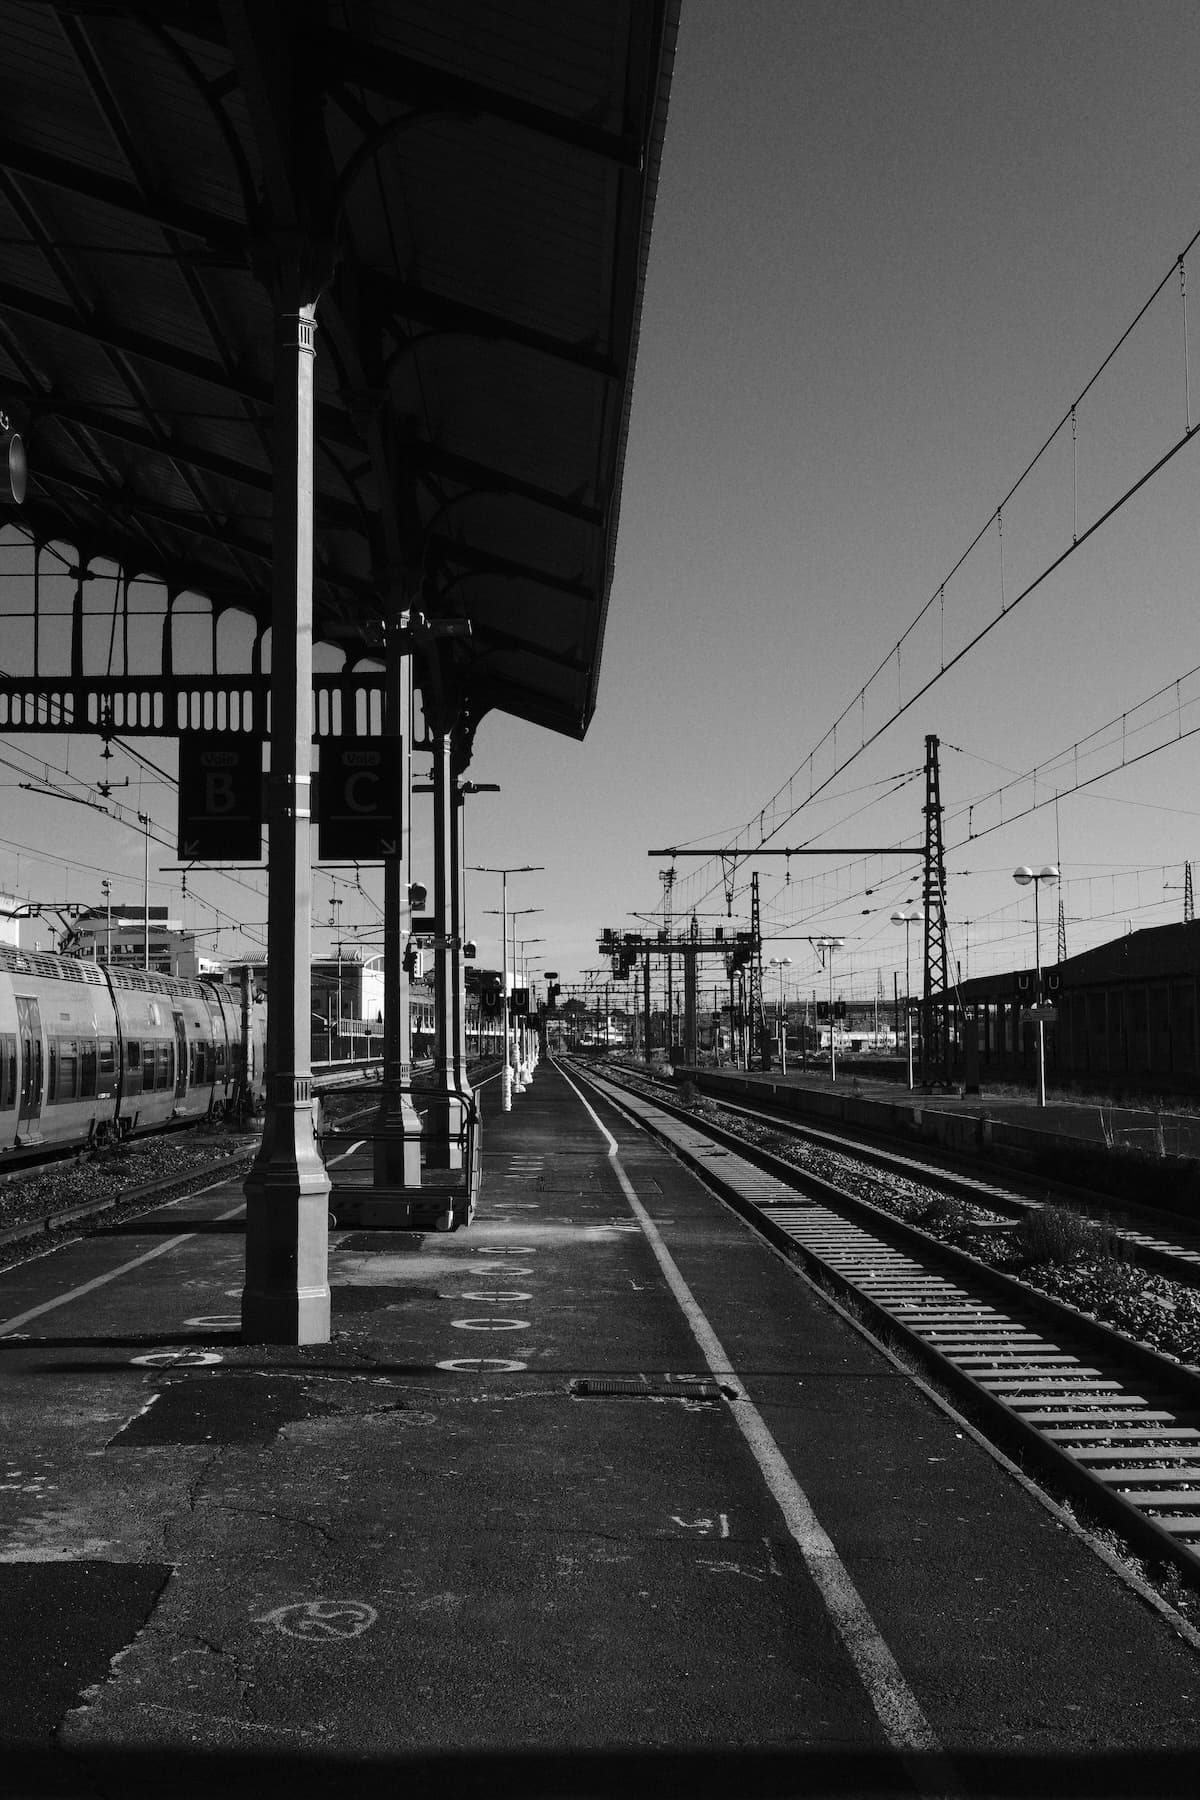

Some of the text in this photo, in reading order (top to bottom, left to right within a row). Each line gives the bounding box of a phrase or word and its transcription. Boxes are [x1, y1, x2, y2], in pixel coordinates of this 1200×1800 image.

[205, 772, 236, 812] B
[344, 771, 379, 812] C
[1018, 975, 1029, 990] U
[1049, 975, 1059, 990] U
[486, 992, 496, 1006] U
[515, 992, 525, 1006] U
